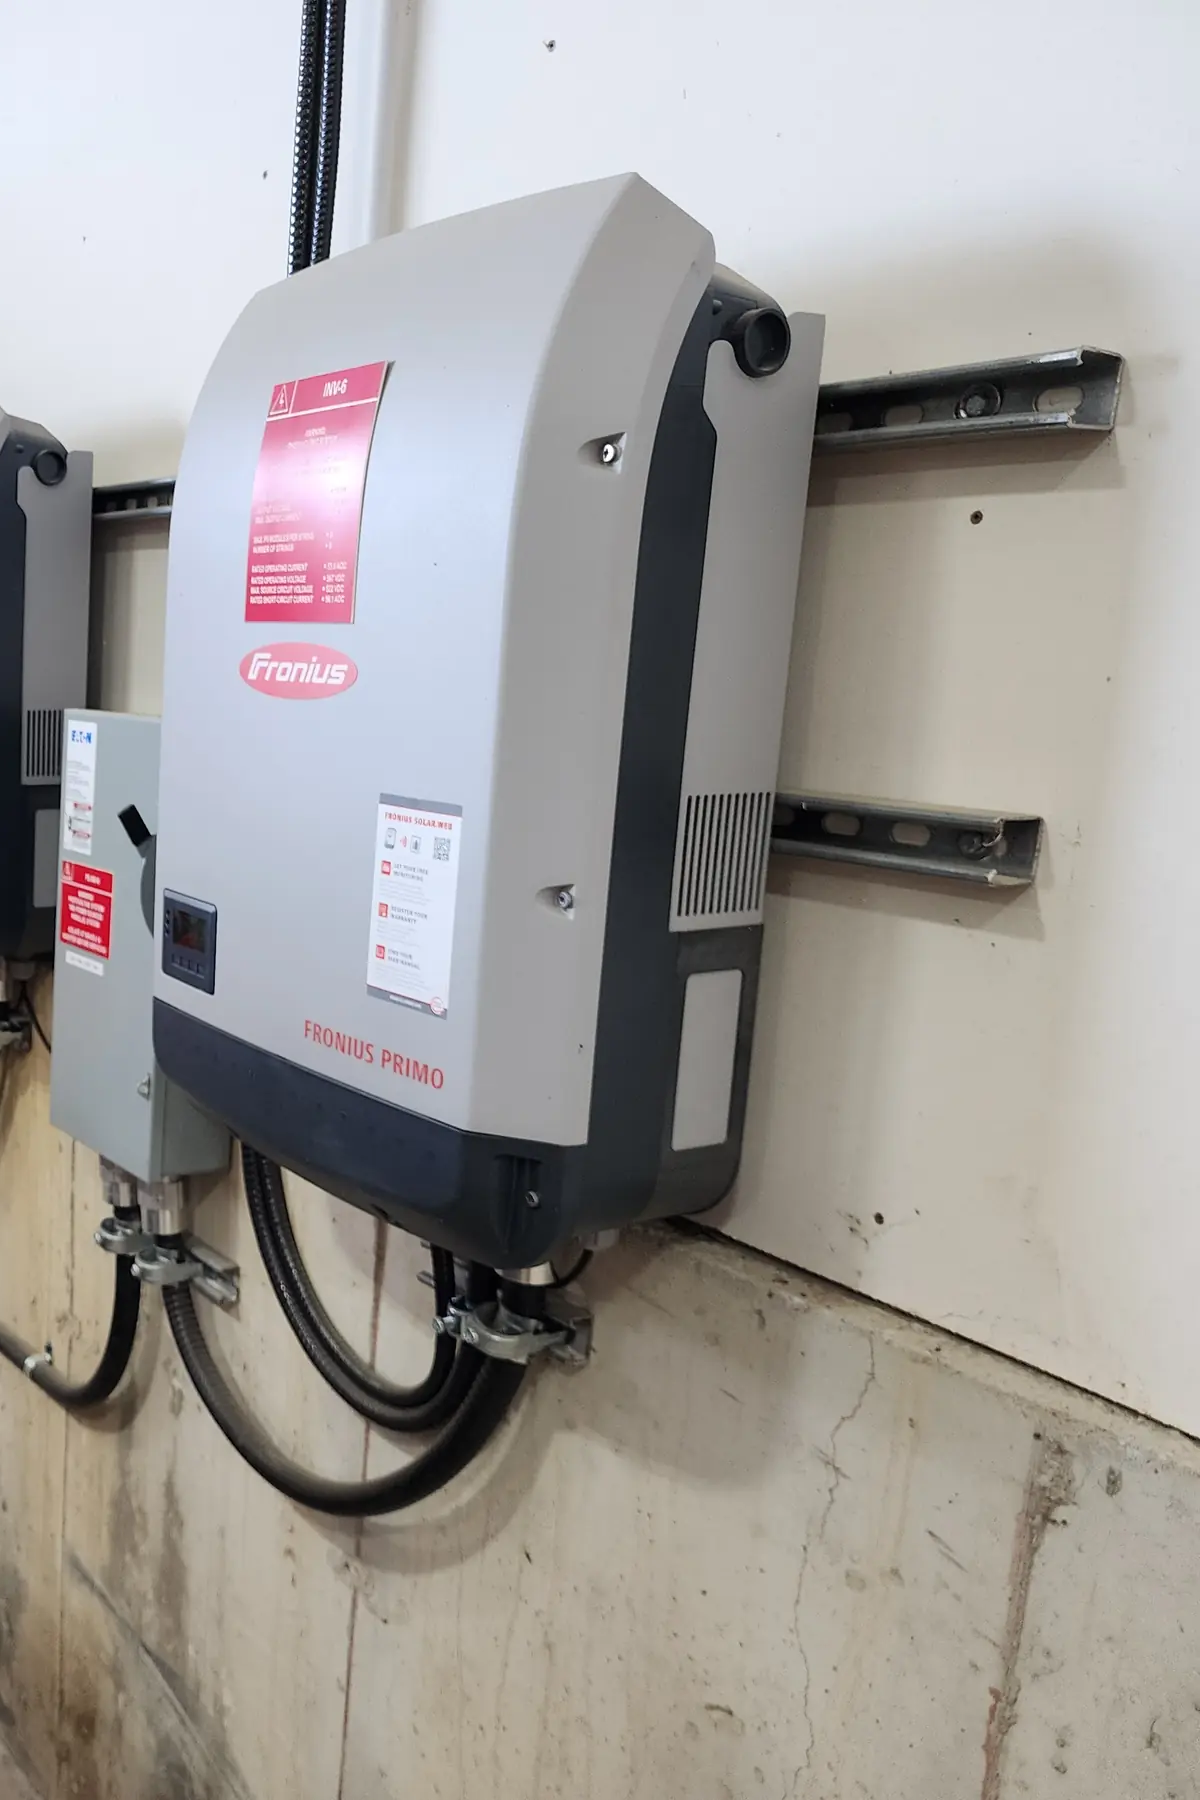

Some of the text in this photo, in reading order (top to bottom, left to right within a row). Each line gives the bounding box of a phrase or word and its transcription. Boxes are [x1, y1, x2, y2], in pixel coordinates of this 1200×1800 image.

[322, 378, 349, 397] INV-6
[247, 652, 349, 685] Fronius
[384, 811, 412, 823] FRONIUS
[304, 1019, 445, 1089] FRONIUS PRIMO
